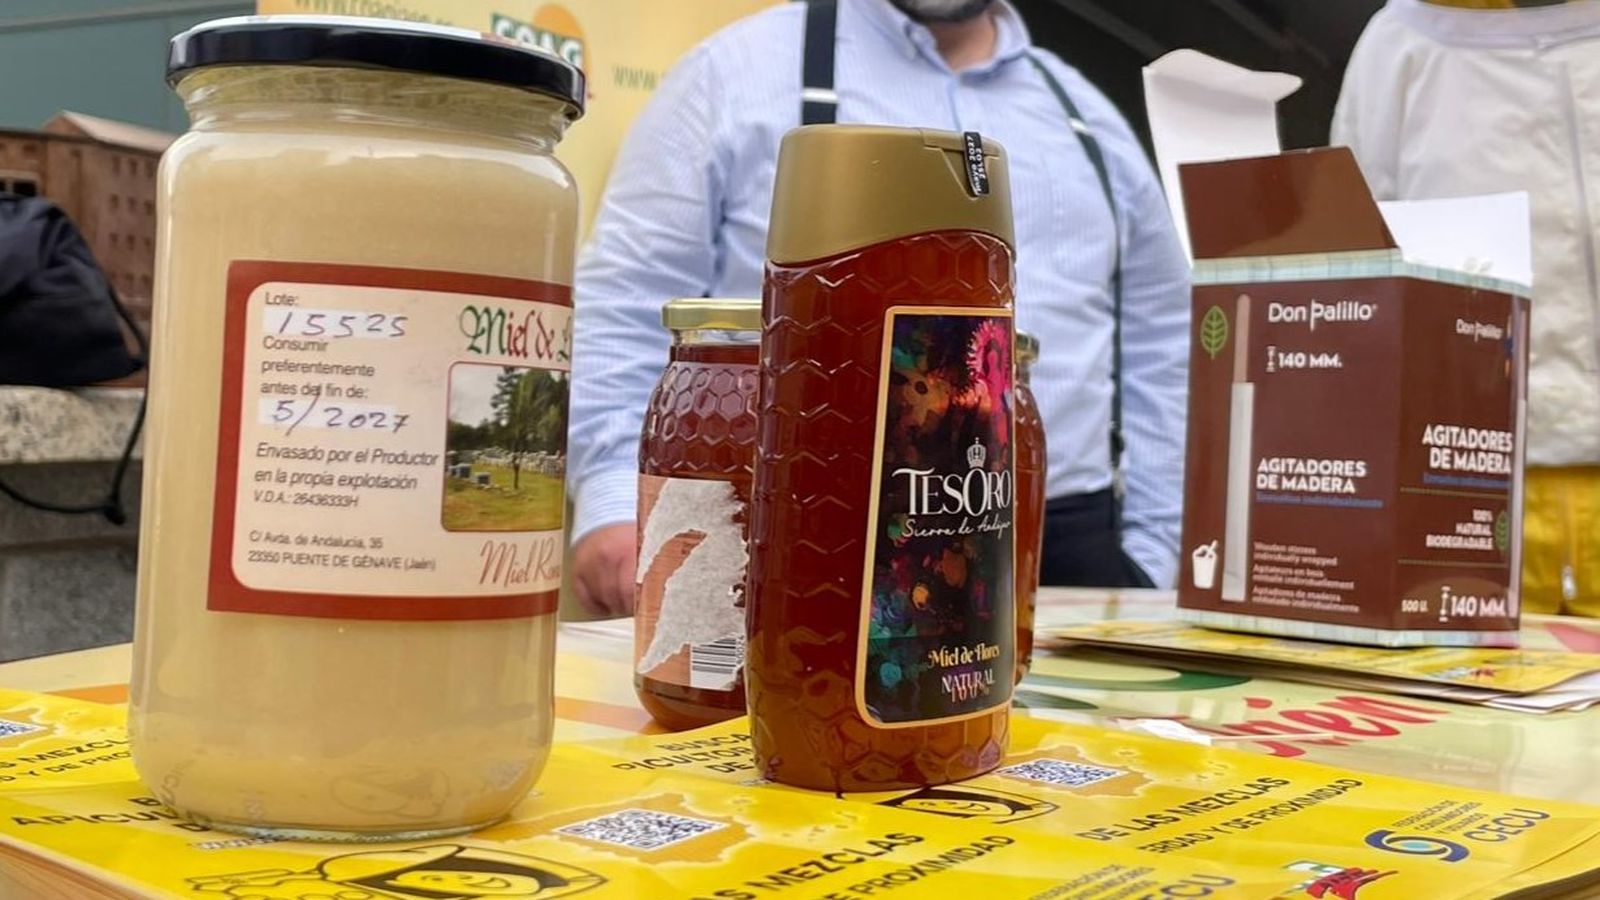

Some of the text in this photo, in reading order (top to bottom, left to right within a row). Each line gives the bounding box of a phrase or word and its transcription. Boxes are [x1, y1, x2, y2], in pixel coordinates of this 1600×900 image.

[264, 291, 299, 308] Lote:
[1268, 302, 1307, 322] Don
[278, 313, 410, 339] 15525
[459, 303, 535, 360] Miel
[1456, 318, 1475, 335] Don
[262, 335, 328, 352] Consumir
[260, 359, 376, 378] preferentemente
[1278, 352, 1343, 368] 140 MM.
[260, 381, 298, 396] antes
[325, 382, 343, 398] fin
[346, 383, 369, 399] de:
[1422, 424, 1513, 451] AGITADORES
[256, 442, 440, 467] Envasado por el Productor
[1430, 447, 1511, 474] DE MADERA
[1257, 457, 1367, 477] AGITADORES
[254, 469, 418, 491] en la propia explotación
[1256, 473, 1356, 494] DE MADERA
[901, 518, 956, 538] Sierra
[958, 516, 974, 535] de
[1455, 522, 1492, 536] NATURAL
[295, 533, 309, 546] de
[369, 537, 383, 550] 35
[282, 552, 330, 568] PUENTE
[332, 554, 350, 568] DE
[479, 540, 537, 588] Miel
[1401, 599, 1418, 613] 500
[1450, 596, 1477, 616] 140
[928, 645, 960, 669] Miel
[960, 645, 974, 664] de
[941, 668, 997, 693] NATURAL
[705, 761, 755, 774] DE
[1076, 776, 1291, 842] DE LAS MEZCLAS
[1205, 824, 1233, 835] Y
[1221, 817, 1262, 830] DE
[1252, 778, 1364, 822] PROXIMIDAD
[12, 810, 179, 825] APICUL
[1463, 807, 1550, 843] CECU
[744, 832, 926, 893] MEZCLAS
[844, 833, 1016, 899] PROXIMIDAD
